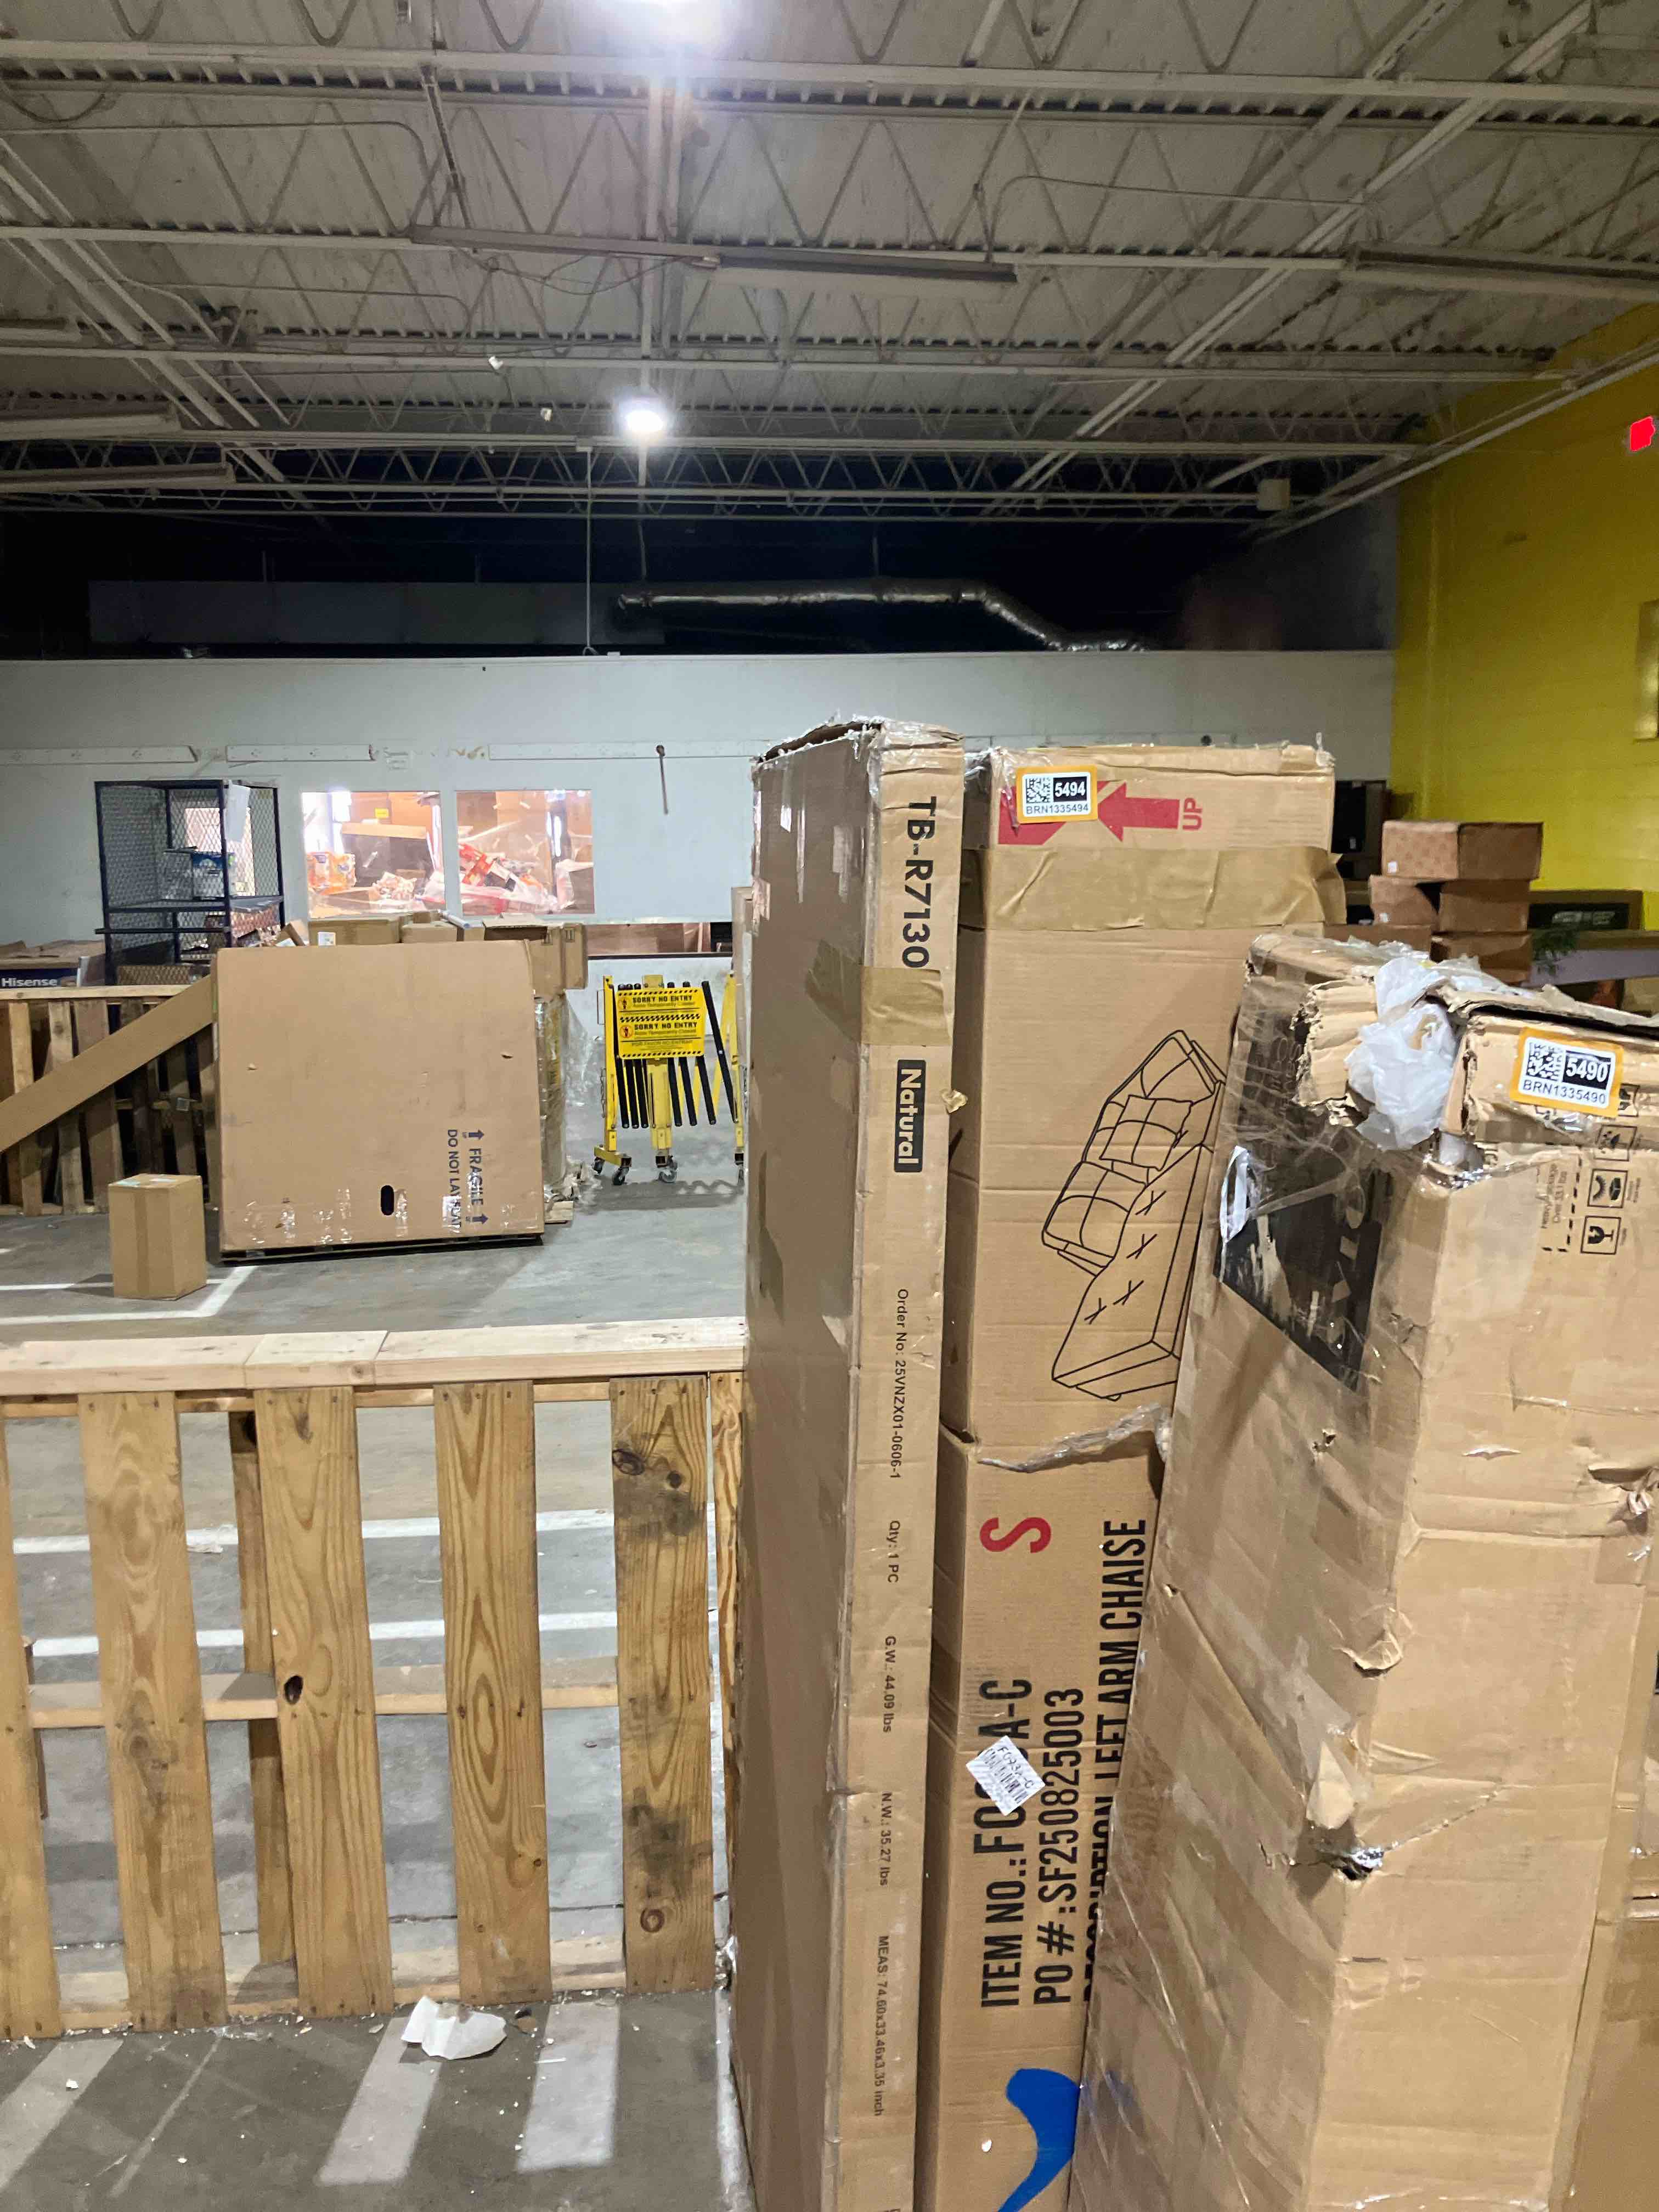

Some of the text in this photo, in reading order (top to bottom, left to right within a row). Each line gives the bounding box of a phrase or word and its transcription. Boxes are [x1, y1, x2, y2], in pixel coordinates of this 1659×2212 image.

[1054, 781, 1086, 797] 5494
[1026, 804, 1088, 815] BRN1335494
[1182, 797, 1203, 831] UP
[902, 796, 937, 968] TB-R7130
[1, 978, 58, 987] Hisense
[1566, 1057, 1609, 1082] 5490
[1523, 1080, 1606, 1104] BRN1335490
[898, 1069, 922, 1164] Natural
[448, 1130, 458, 1147] DO
[448, 1151, 459, 1174] NOT
[469, 1148, 483, 1206] FRAGILE
[890, 1289, 909, 1480] Order No: 25VNZX01-0606-1
[887, 1520, 900, 1548] Qty:
[979, 1517, 1052, 1554] S
[888, 1565, 899, 1583] PC
[1099, 1519, 1146, 1630] CHAISE
[1098, 1640, 1138, 1704] ARM
[884, 1675, 896, 1709] 44.09
[883, 1712, 894, 1733] lbs
[880, 1830, 891, 1863] 35.27
[879, 1866, 890, 1886] lbs
[981, 1934, 1023, 2008] ITEM
[1034, 1965, 1074, 2005] PO
[874, 1981, 888, 2087] 74.60x33.46x3.35
[873, 2091, 885, 2117] inch
